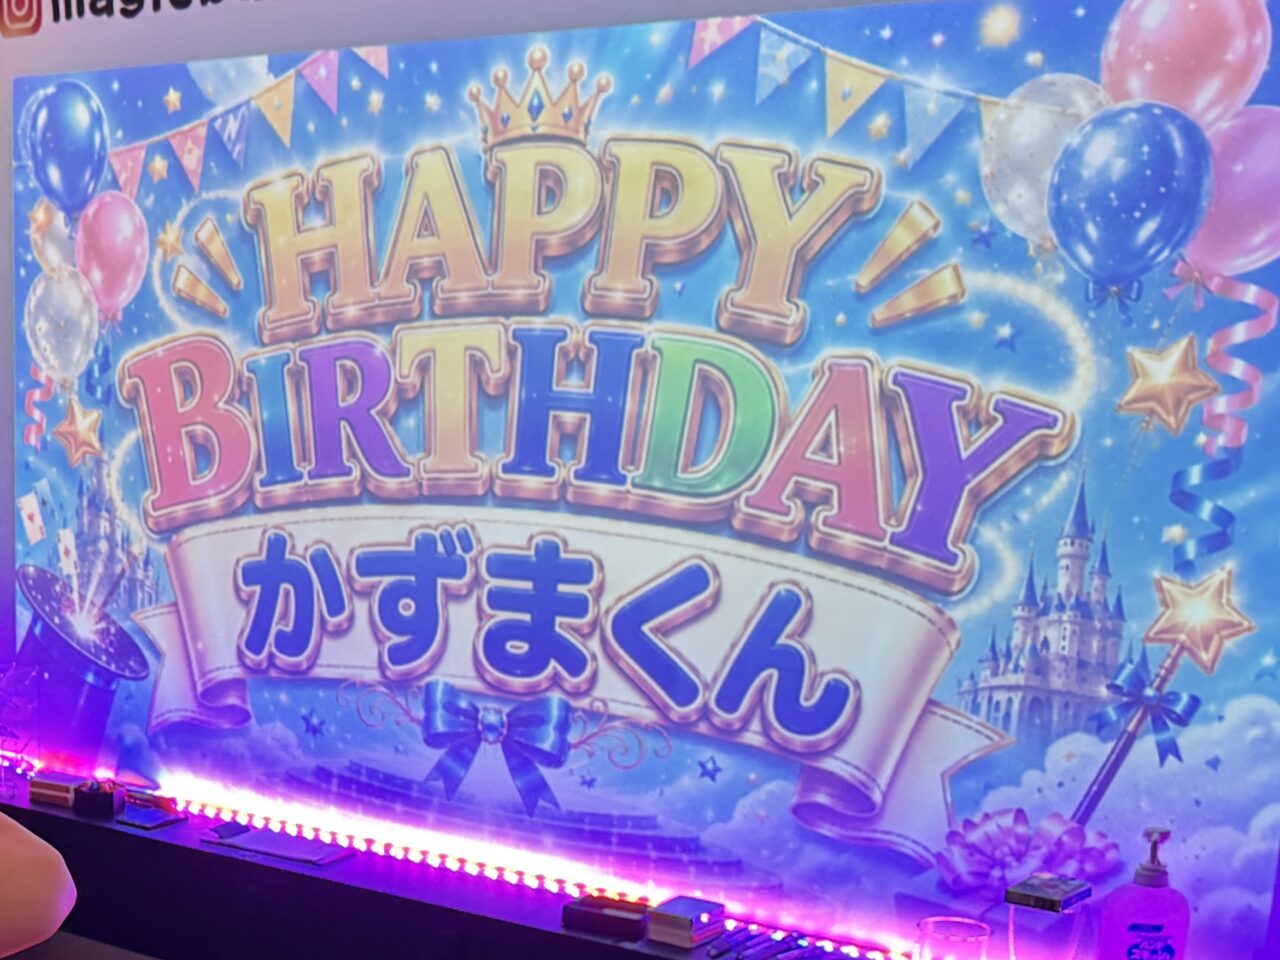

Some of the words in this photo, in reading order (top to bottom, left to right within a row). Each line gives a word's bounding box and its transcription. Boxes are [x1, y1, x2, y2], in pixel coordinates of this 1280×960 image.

[243, 138, 882, 345] HAPPY
[119, 318, 1075, 595] BIRTHDAY
[235, 524, 857, 754] かずまくん
